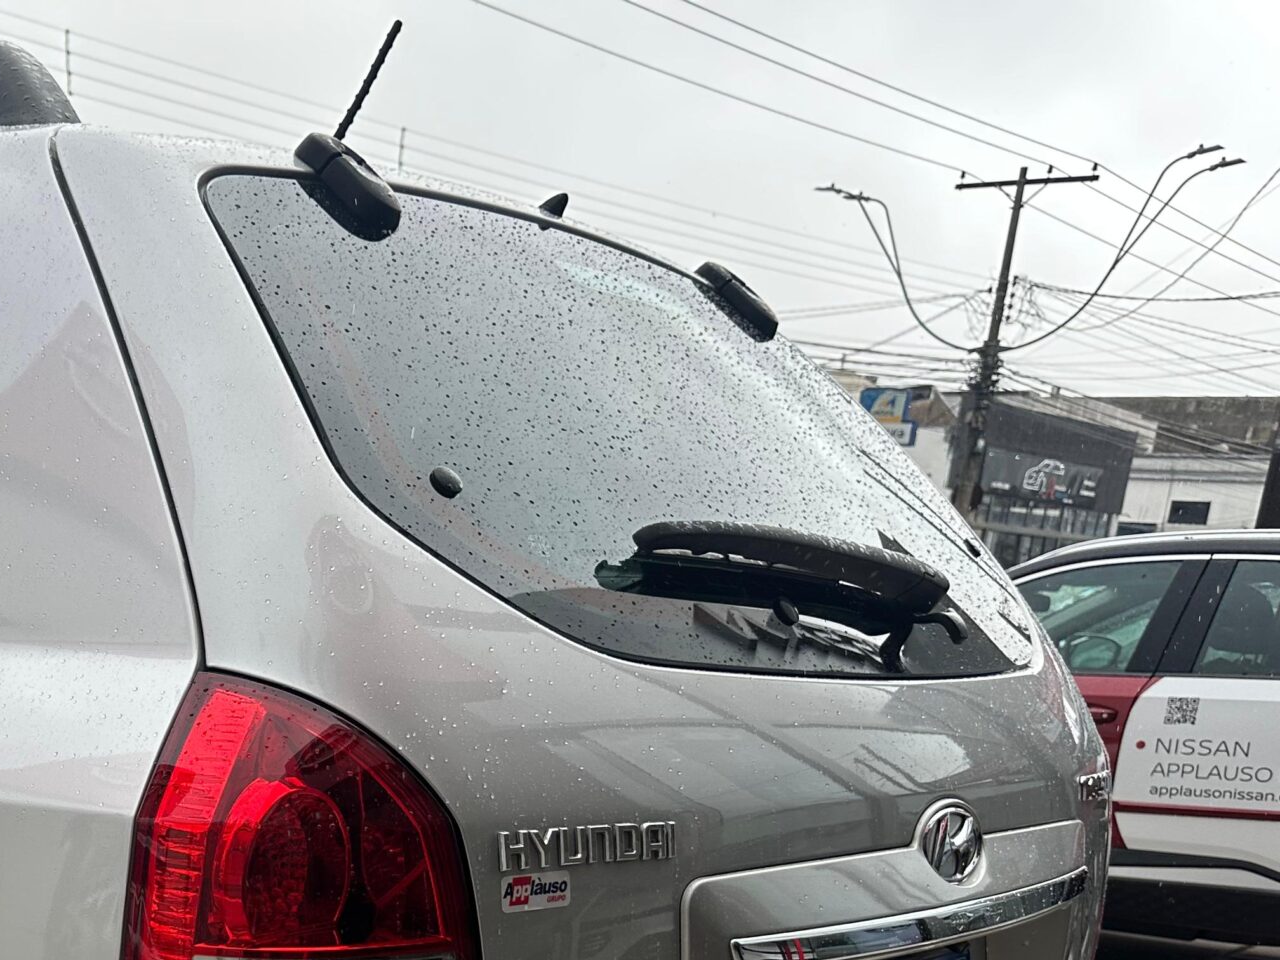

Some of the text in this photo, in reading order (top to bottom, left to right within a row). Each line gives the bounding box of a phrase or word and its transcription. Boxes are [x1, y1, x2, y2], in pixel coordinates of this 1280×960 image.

[1155, 738, 1251, 758] NISSAN
[1150, 762, 1274, 783] APPLAUSO
[1149, 785, 1280, 803] applausonissan.
[497, 820, 677, 872] HYUNDAI
[546, 894, 567, 904] GRUPO
